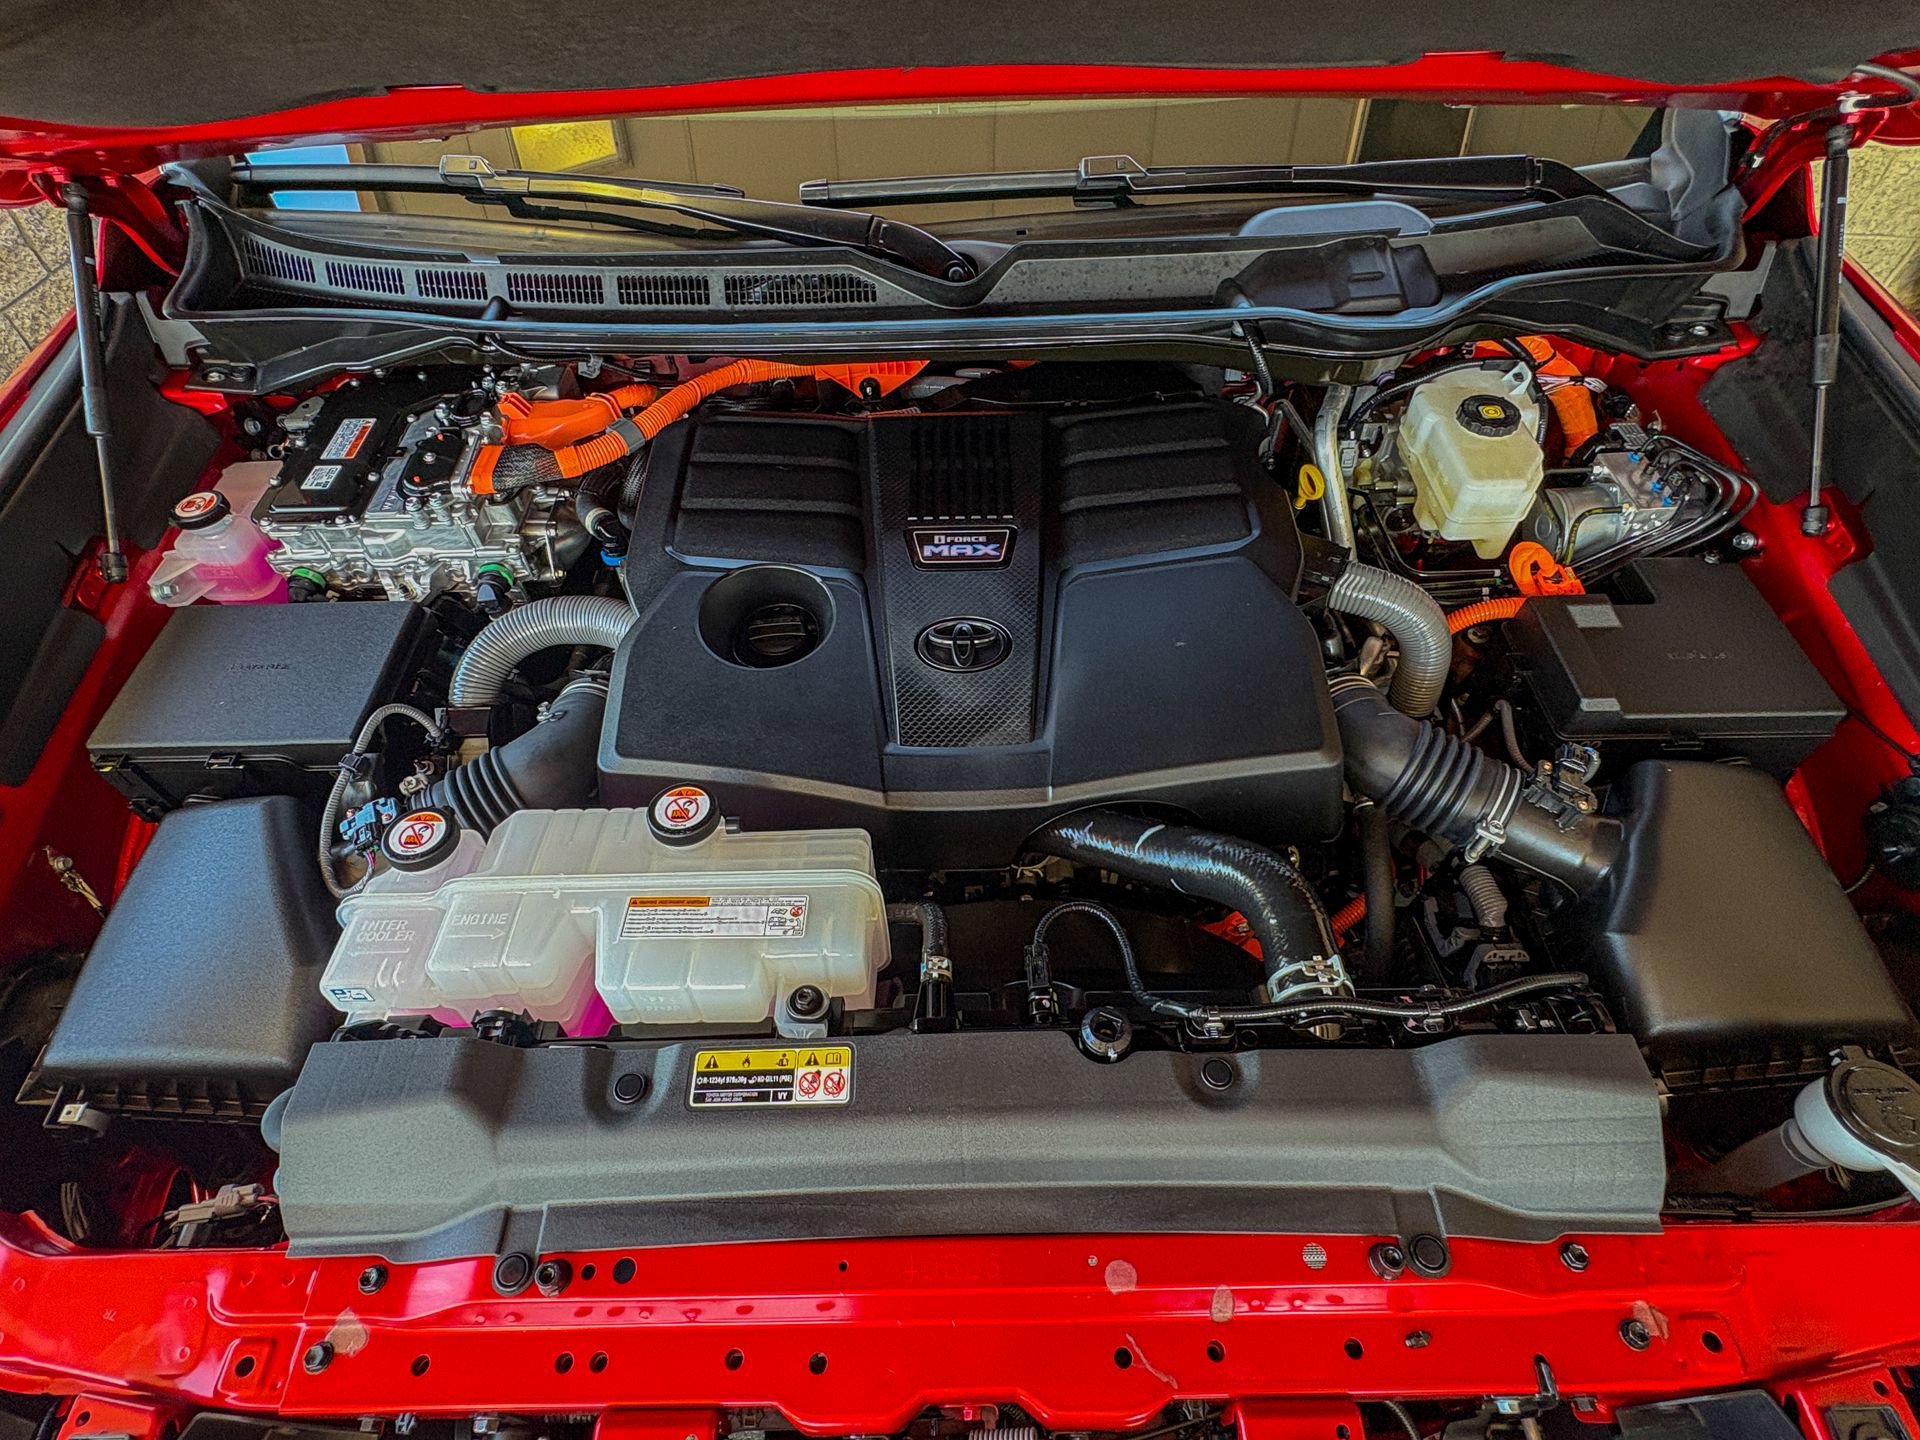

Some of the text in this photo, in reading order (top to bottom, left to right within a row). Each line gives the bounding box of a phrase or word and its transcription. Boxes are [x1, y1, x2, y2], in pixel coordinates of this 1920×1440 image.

[923, 544, 1000, 557] MAX
[360, 919, 409, 931] INTER
[450, 912, 509, 926] ENGINE
[356, 930, 415, 943] COOLER
[777, 1091, 788, 1100] VY
